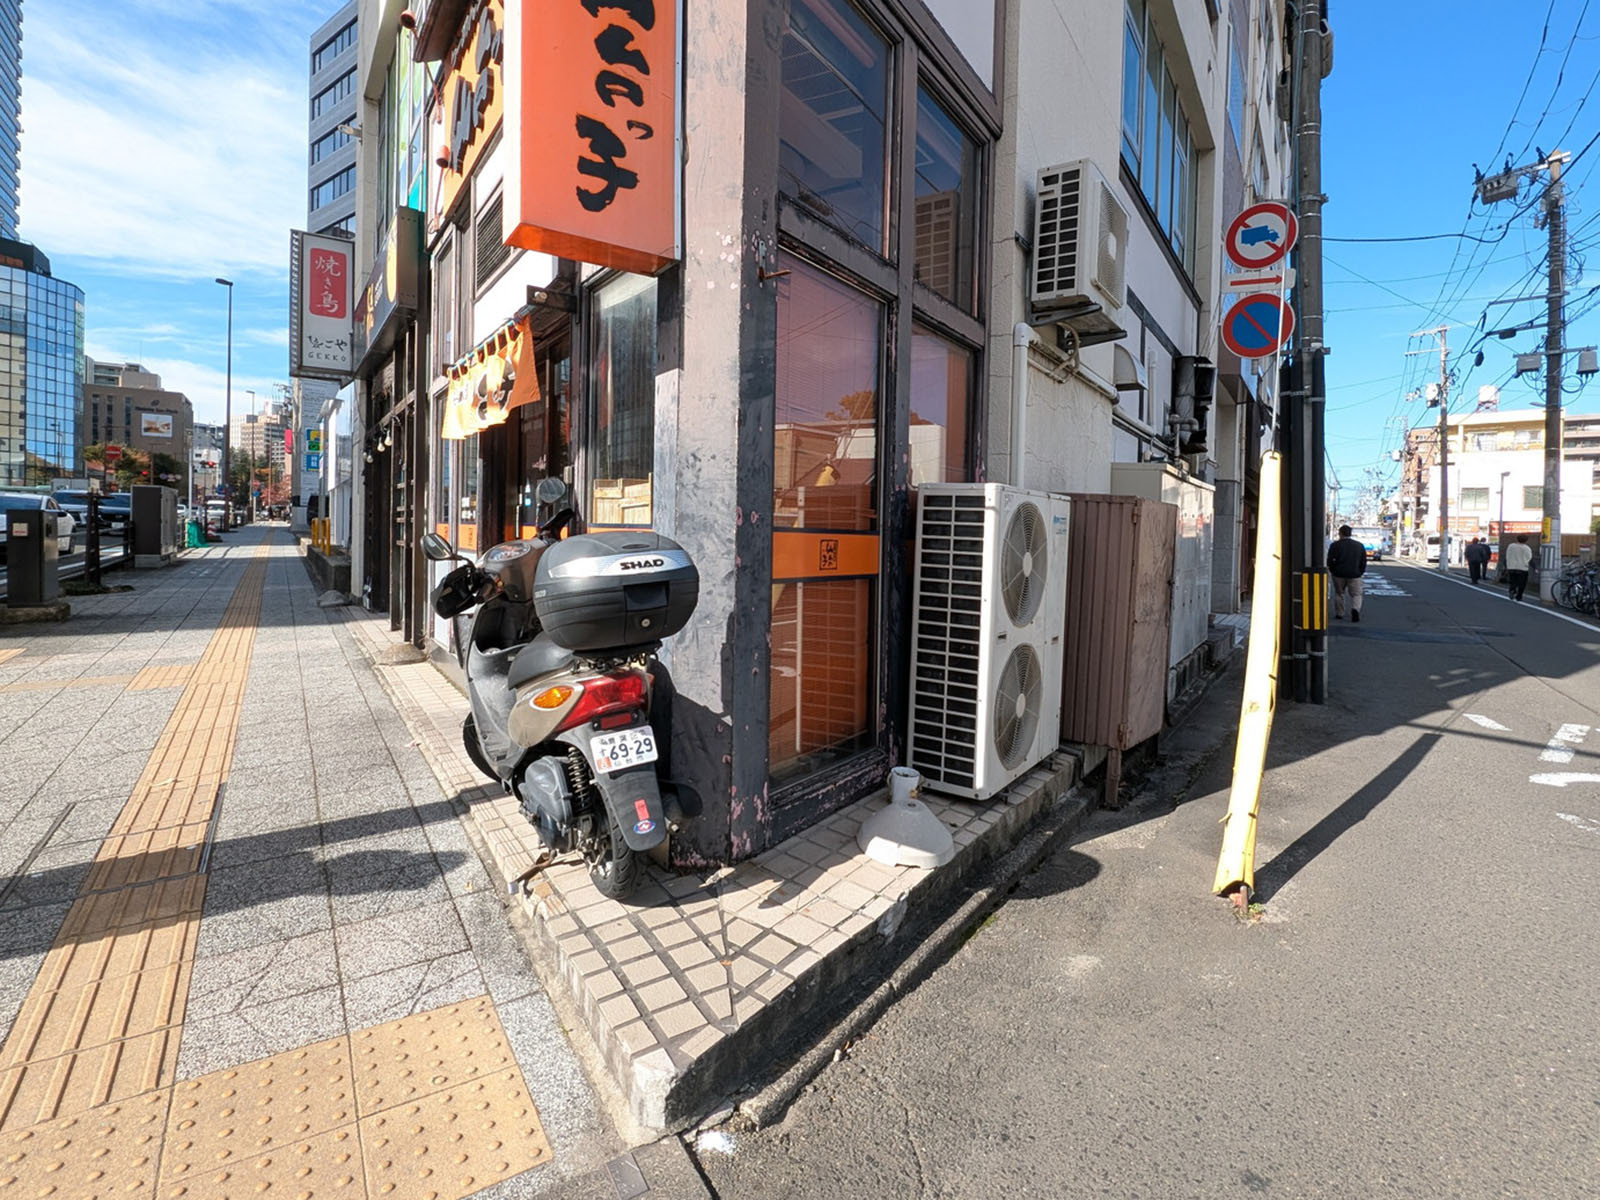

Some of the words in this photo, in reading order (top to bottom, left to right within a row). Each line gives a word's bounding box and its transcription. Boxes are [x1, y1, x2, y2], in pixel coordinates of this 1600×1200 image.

[315, 255, 341, 313] 焼き鳥
[308, 351, 347, 362] GEKKO
[620, 559, 664, 570] SHAD
[609, 737, 654, 760] 69-29
